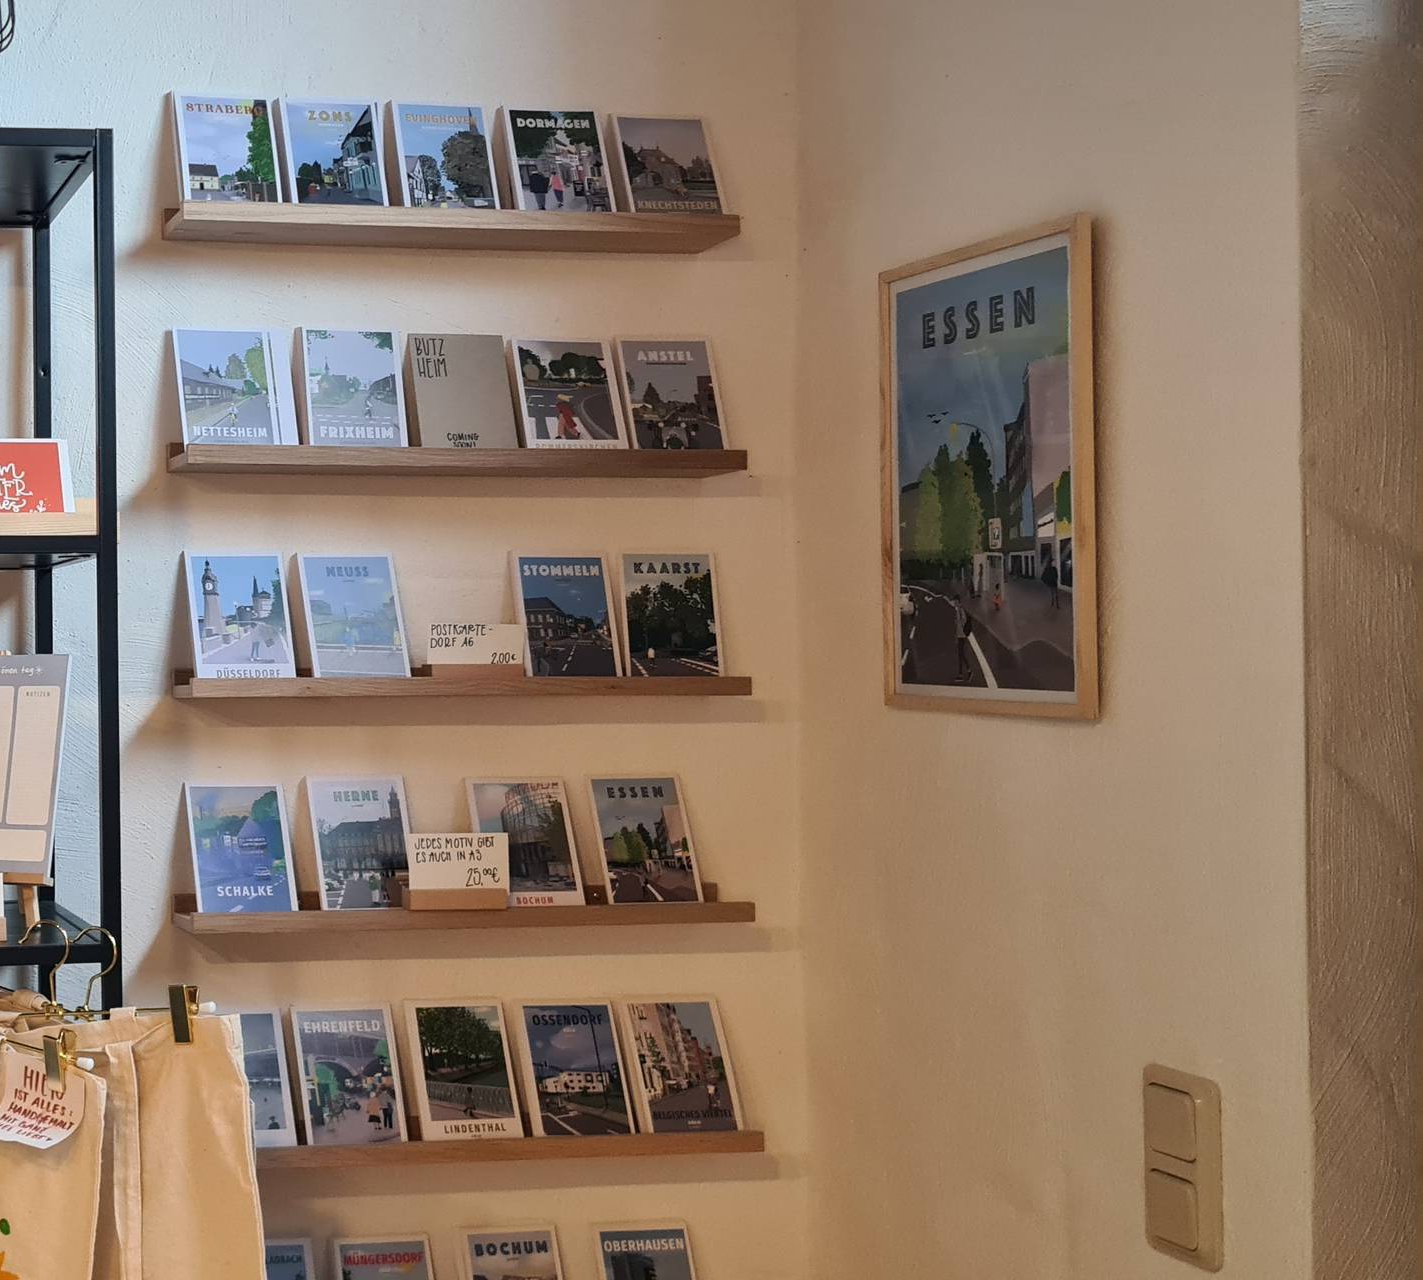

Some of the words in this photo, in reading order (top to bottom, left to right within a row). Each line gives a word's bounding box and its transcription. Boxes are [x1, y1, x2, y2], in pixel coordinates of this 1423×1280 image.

[307, 110, 354, 122] ZONS
[516, 117, 591, 130] DORMAGEN
[637, 201, 718, 210] KNECHTSTEDEN
[921, 286, 1036, 349] ESSEN
[414, 337, 444, 357] BUTZ
[637, 349, 694, 362] ANSTEL
[417, 358, 448, 378] HEIM
[192, 425, 268, 438] NETTESHEIM
[319, 425, 394, 439] FRIXHEIM
[446, 432, 479, 442] COMING
[325, 566, 370, 578] NEUSS
[522, 564, 600, 577] STOMMELN
[633, 562, 700, 574] KAARST
[430, 637, 457, 649] DORF
[461, 636, 475, 648] A6
[216, 667, 281, 678] DÜSSELDORF
[332, 790, 380, 802] HERNE
[607, 785, 665, 800] ESSEN
[414, 837, 442, 850] JEDES
[444, 836, 474, 849] MOTIV
[477, 836, 495, 849] GIBT
[415, 851, 427, 864] ES
[428, 850, 452, 863] AUCH
[456, 850, 466, 862] IN
[469, 848, 483, 862] A3
[217, 885, 275, 898] SCHALKE
[516, 896, 554, 905] BOCHUM
[531, 1014, 603, 1026] OSSENDORF
[303, 1020, 381, 1034] EHRENFELD
[13, 1087, 28, 1102] IST
[0, 1113, 17, 1124] MIT
[7, 1101, 75, 1132] HANDGEMALT
[443, 1122, 507, 1134] LINDENTHAL
[473, 1240, 549, 1257] BOCHUM
[603, 1237, 685, 1252] OBERHAUSEN
[343, 1251, 424, 1266] MÜNGERSDORF
